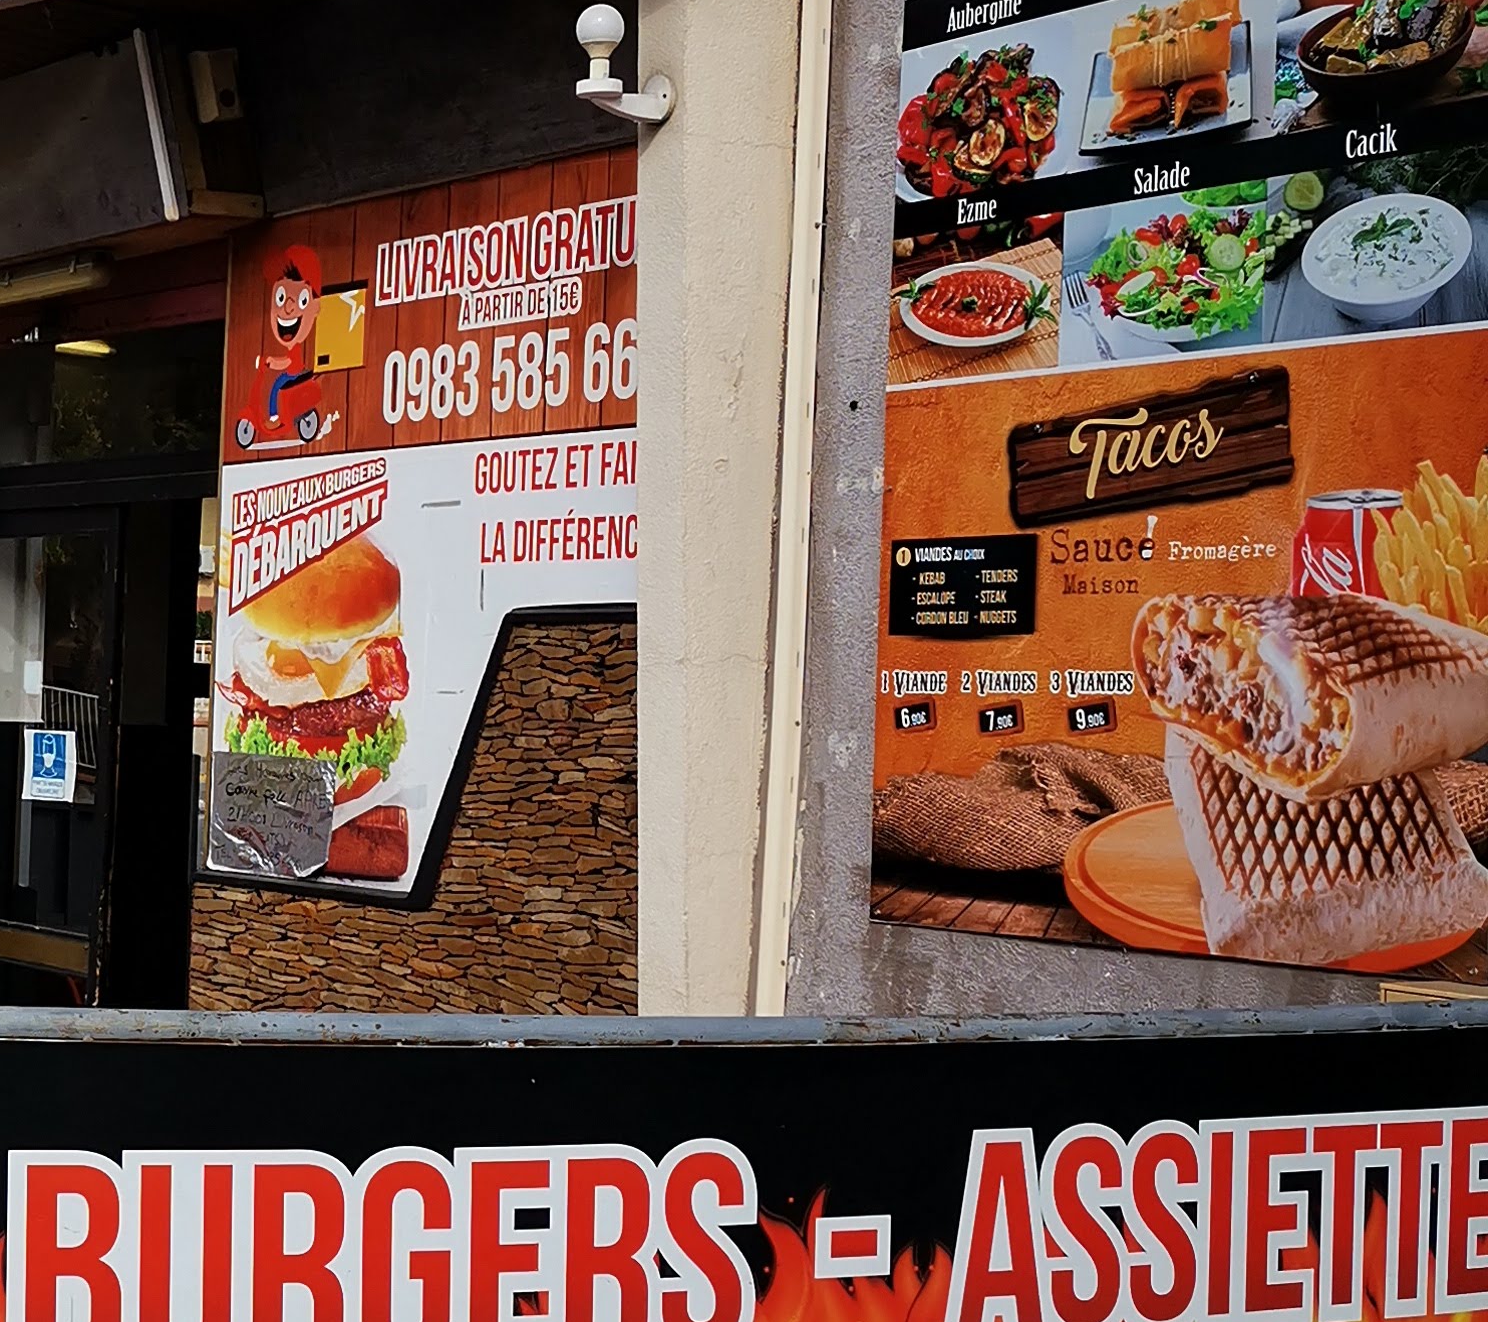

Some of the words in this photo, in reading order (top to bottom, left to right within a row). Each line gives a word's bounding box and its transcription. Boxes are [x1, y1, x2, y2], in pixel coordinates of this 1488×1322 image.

[1344, 121, 1399, 160] Cacik
[1132, 160, 1191, 196] Salade
[956, 195, 998, 226] Ezme
[377, 218, 527, 304] LIVRAISON
[474, 289, 525, 325] PARTIR
[527, 286, 546, 317] DE
[550, 280, 580, 314] 15€
[382, 339, 481, 425] 0983
[490, 326, 571, 414] 585
[583, 317, 637, 404] 66
[1069, 407, 1225, 500] Tacos
[474, 446, 560, 495] GOUTEZ
[565, 443, 595, 489] ET
[233, 492, 257, 532] LES
[257, 475, 324, 524] NOUVEAUX
[323, 458, 386, 496] BURGERS
[231, 487, 385, 609] DÉBARQUENT
[480, 521, 507, 564] LA
[512, 508, 638, 563] DIFFÉRENC
[1167, 535, 1277, 563] Fromagère
[914, 547, 953, 563] VIANDES
[919, 571, 946, 585] KEBAB
[981, 568, 1019, 583] TENDERS
[1061, 574, 1140, 595] Maison
[979, 590, 1007, 604] STEAK
[948, 610, 969, 625] BLEU
[979, 610, 1017, 624] NUGGETS
[881, 671, 889, 694] 1
[894, 671, 947, 696] VIANDE
[961, 671, 971, 693] 2
[976, 671, 1038, 696] VIANDES
[1050, 671, 1061, 694] 3
[1065, 670, 1135, 697] VIANDES
